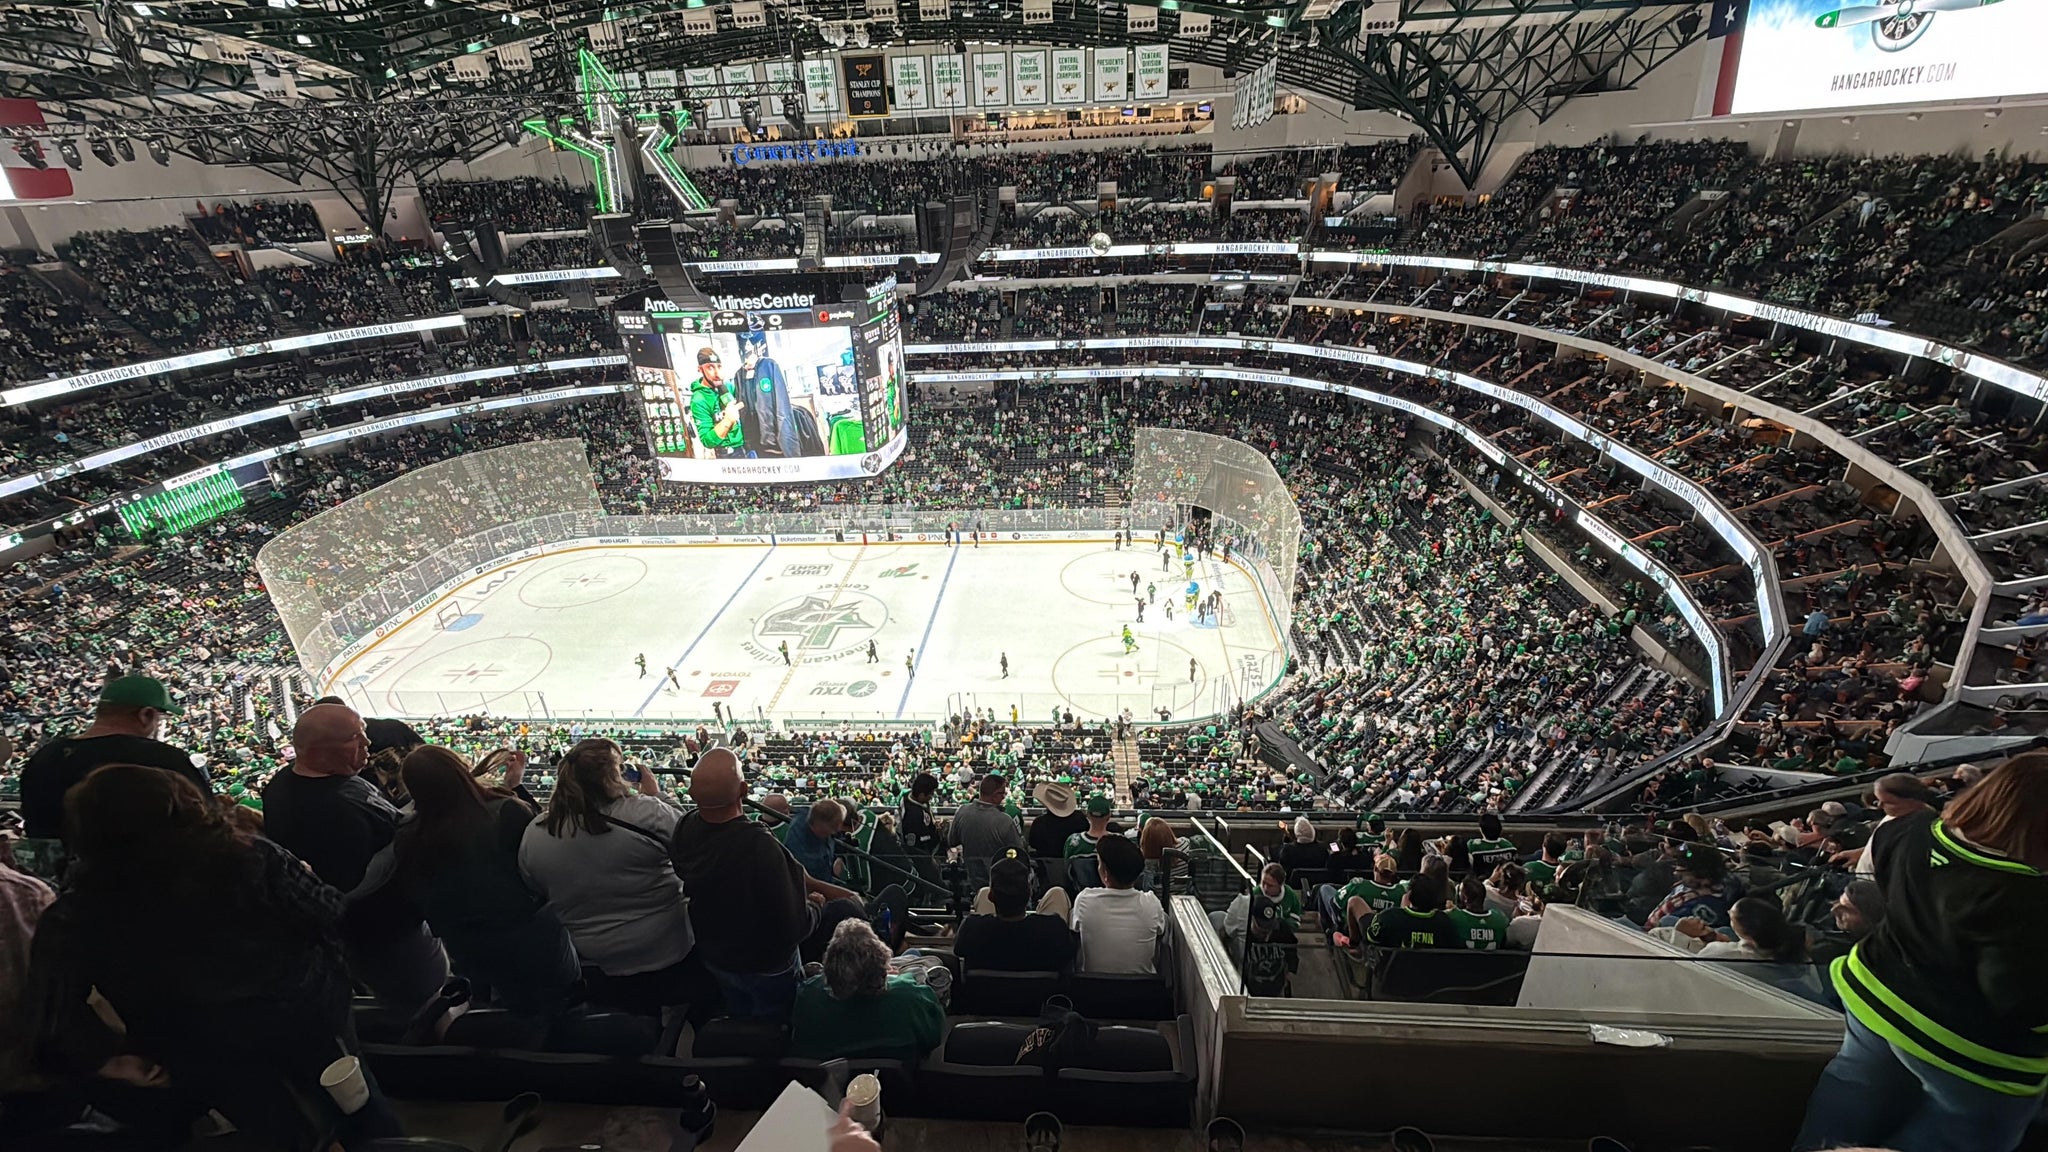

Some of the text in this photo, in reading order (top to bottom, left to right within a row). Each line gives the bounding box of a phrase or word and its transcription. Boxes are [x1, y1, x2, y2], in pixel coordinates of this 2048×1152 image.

[1058, 56, 1079, 64] CENTRAL
[1139, 67, 1164, 75] CHAMPIONS
[1831, 62, 1957, 91] HANGARHOCKEY.COM
[849, 79, 881, 88] STANLEY CUP
[851, 90, 881, 98] CHAMPIONS
[682, 317, 694, 329] 2
[769, 315, 782, 326] 0
[326, 323, 415, 342] HANGARHOCKEY.COM
[69, 360, 172, 389] HANGARHOCKEY.COM
[140, 419, 237, 452] HANGARHOCKEY.COM
[384, 616, 403, 632] PNC
[809, 686, 845, 696] TXU
[1411, 931, 1434, 945] BENN
[1470, 928, 1494, 941] BENN
